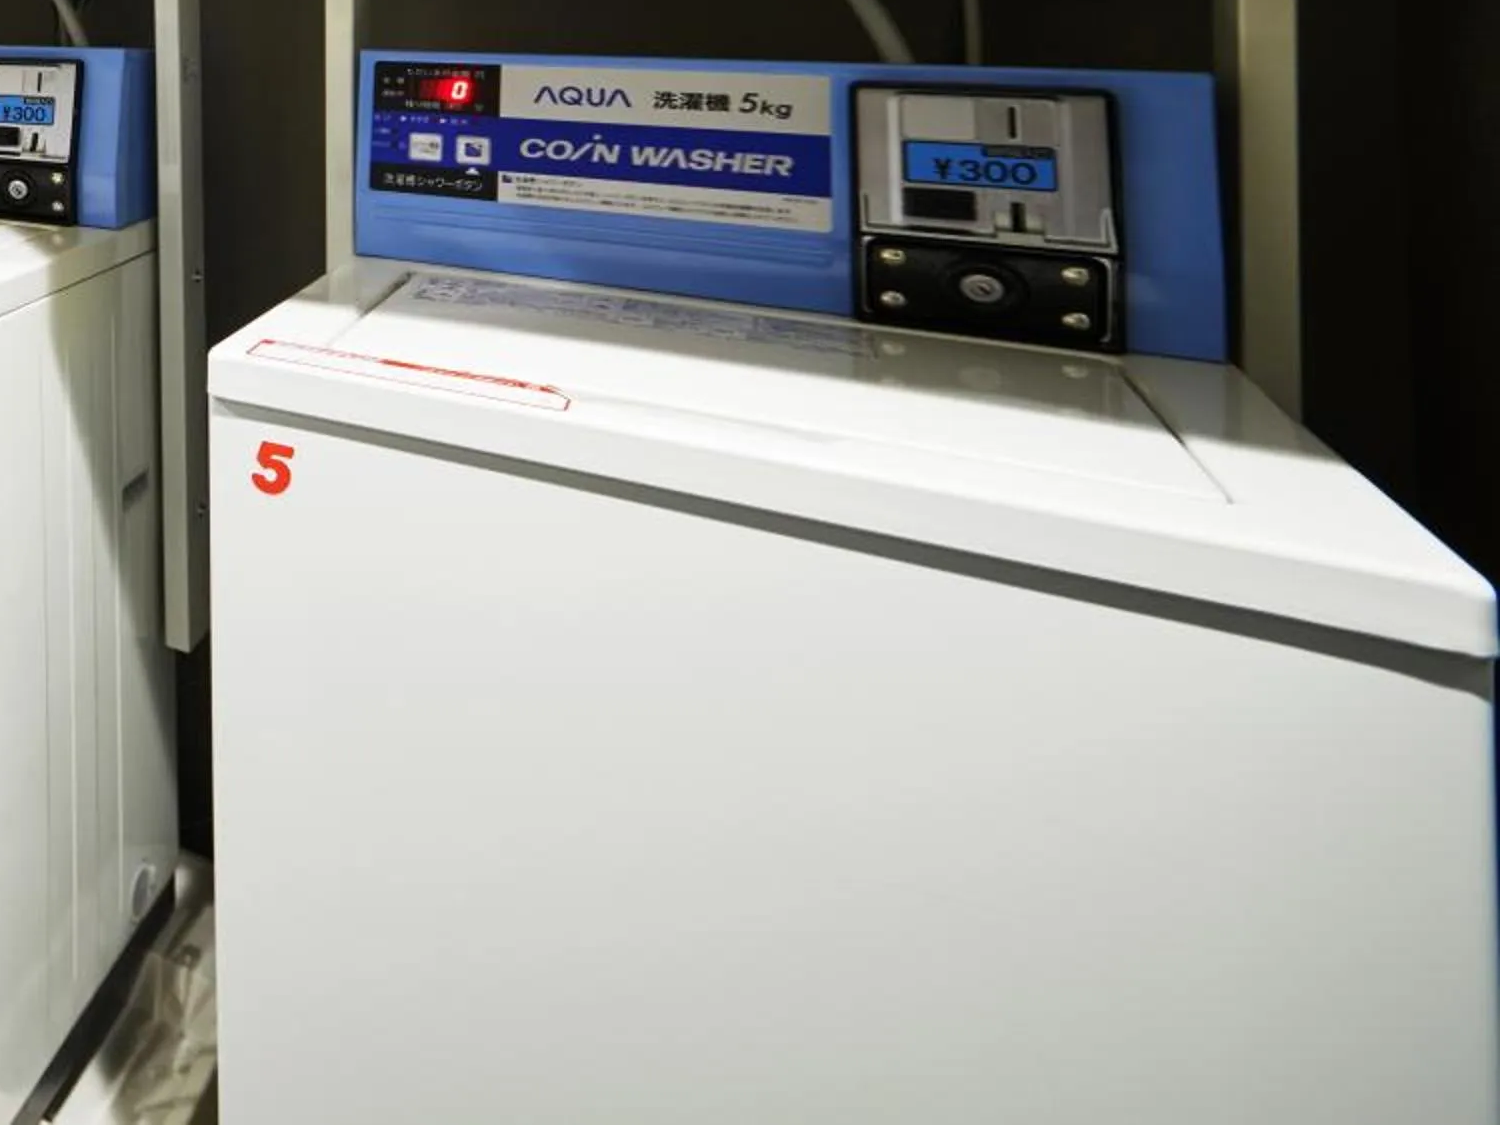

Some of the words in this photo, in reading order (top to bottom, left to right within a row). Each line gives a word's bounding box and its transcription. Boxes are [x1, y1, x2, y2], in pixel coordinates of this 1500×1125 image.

[451, 81, 469, 100] 0
[534, 86, 632, 109] AQUA
[653, 90, 731, 112] 洗濯機
[737, 92, 793, 120] 5kg
[3, 105, 47, 123] ¥300
[631, 146, 795, 177] WASHER
[932, 157, 1039, 186] ¥300
[251, 441, 295, 496] 5
